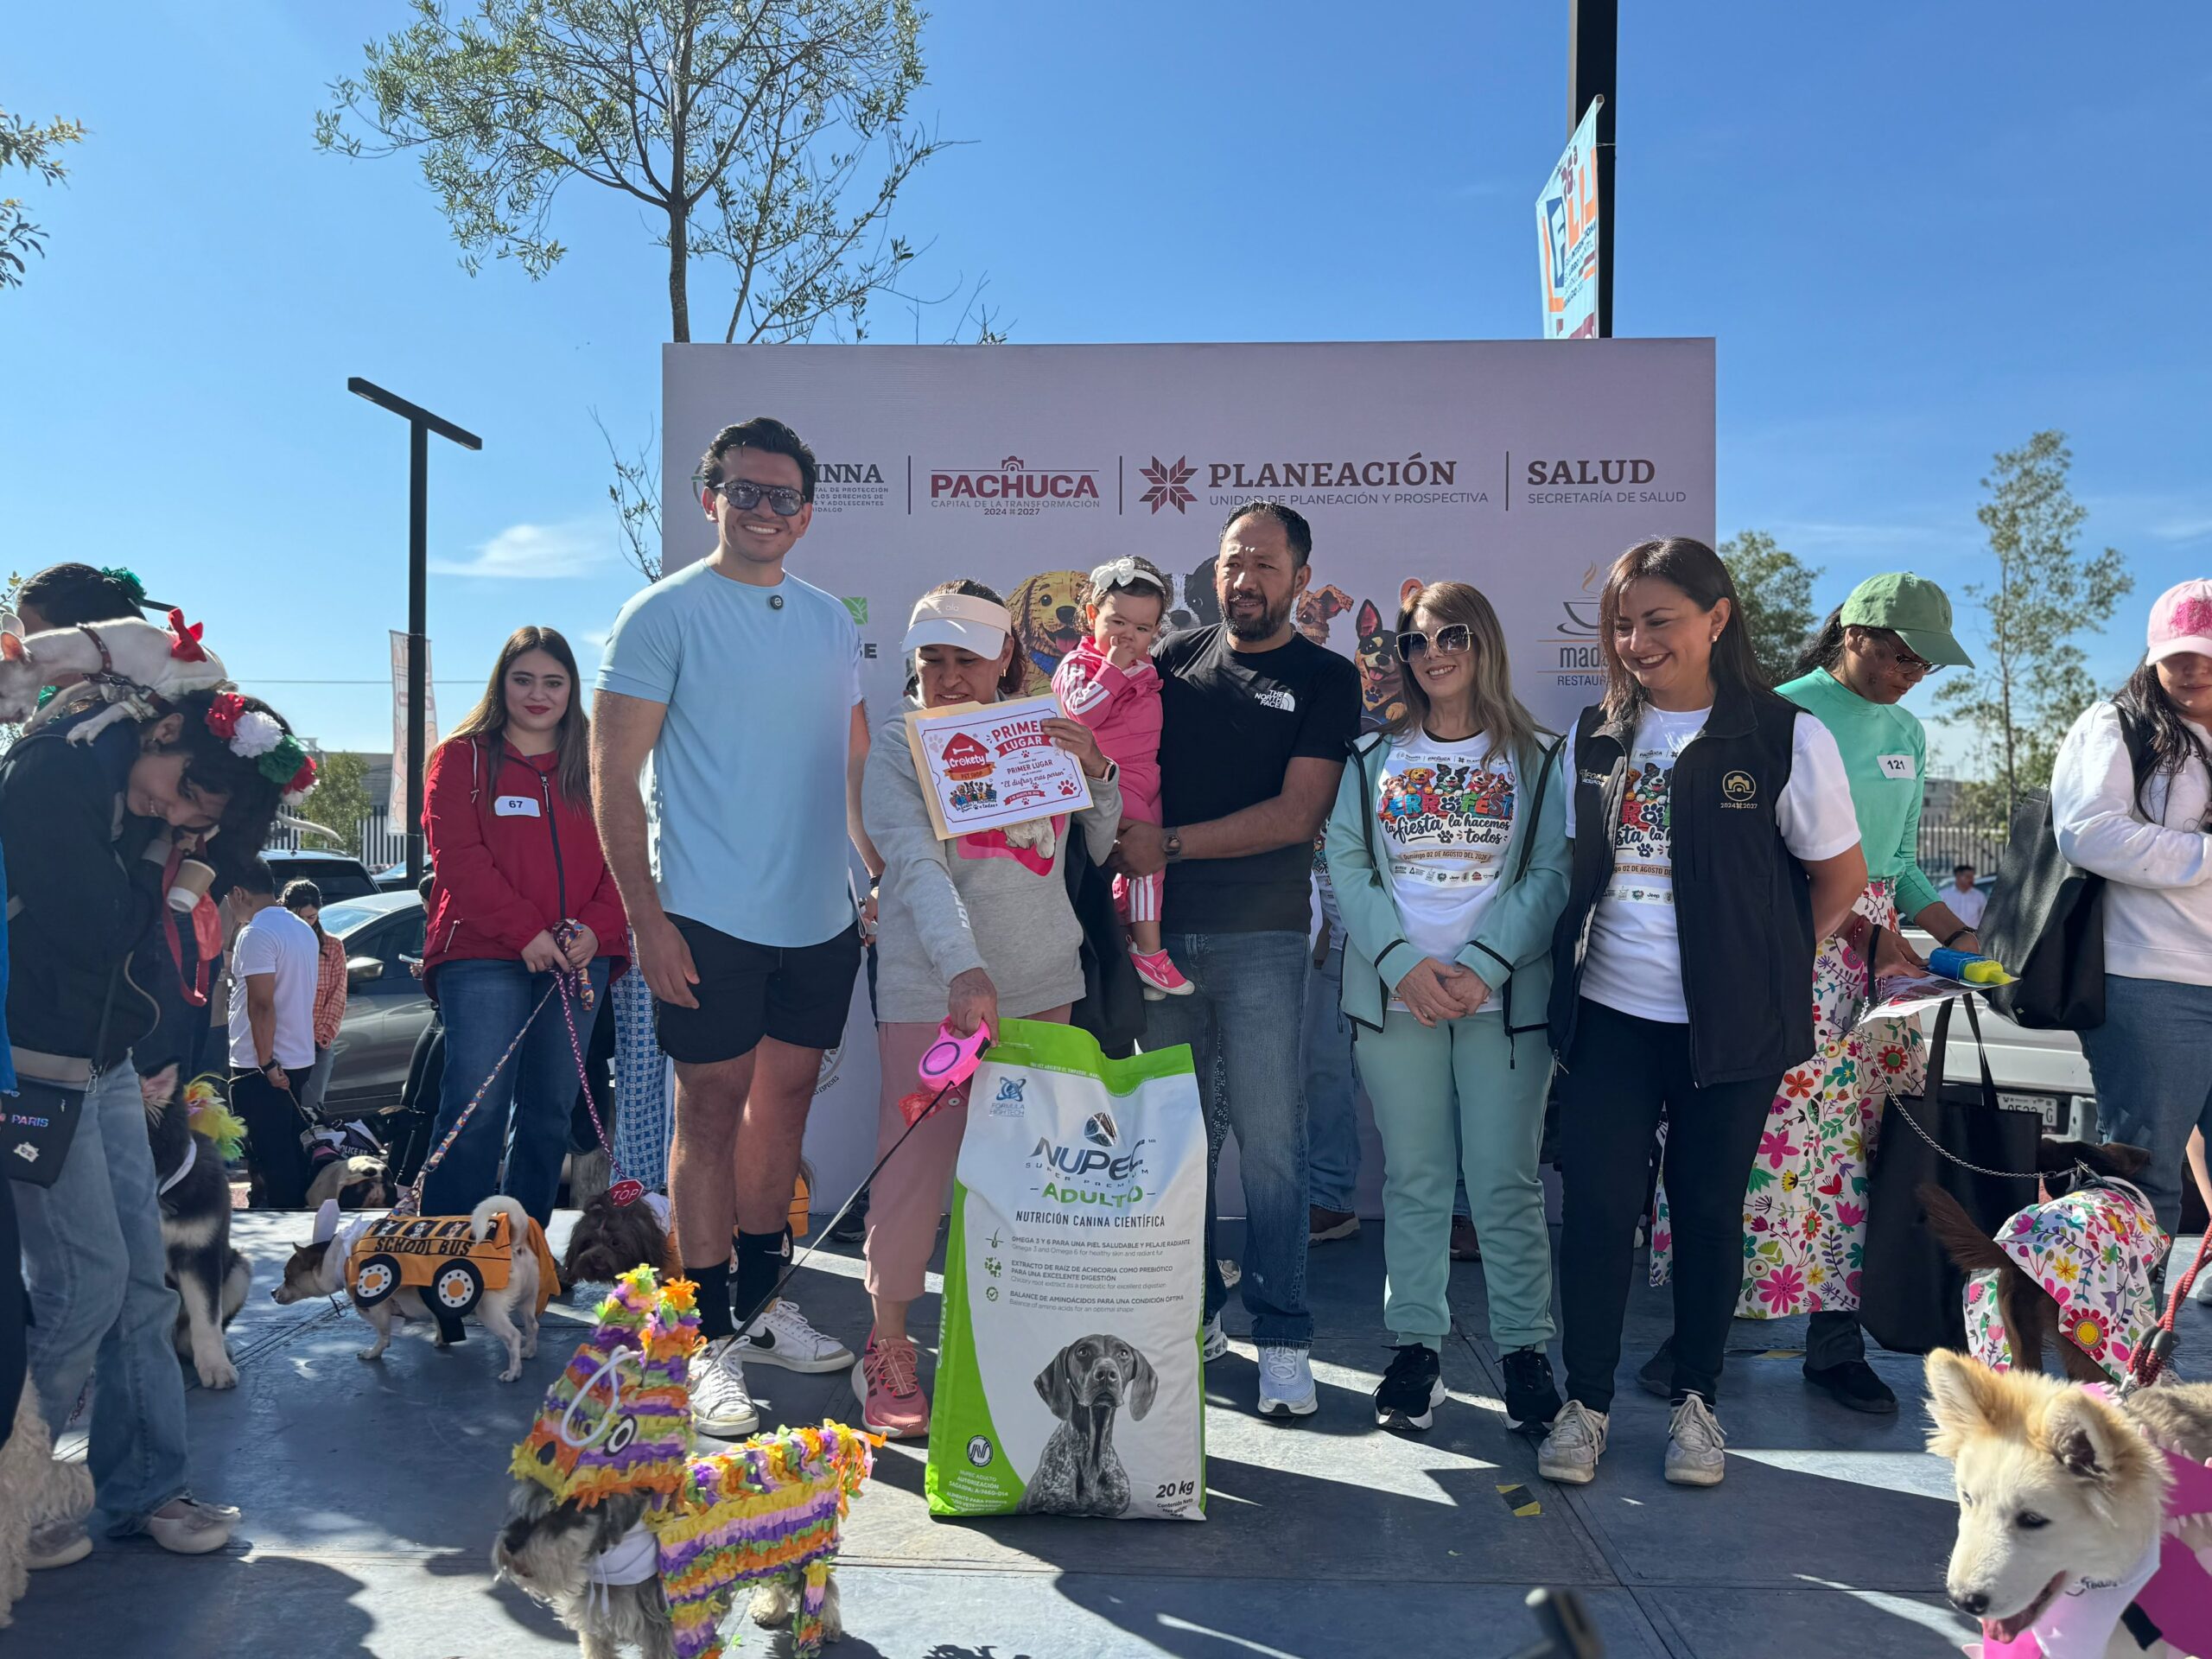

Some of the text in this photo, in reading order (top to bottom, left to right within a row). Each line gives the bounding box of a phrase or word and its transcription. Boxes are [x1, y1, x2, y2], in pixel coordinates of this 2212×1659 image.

[815, 464, 884, 483] INNA
[1208, 452, 1457, 487] PLANEACIÓN
[1528, 460, 1655, 486] SALUD
[931, 474, 1099, 498] PACHUCA
[1005, 498, 1100, 508] TRANSFORMACIÓN
[1210, 493, 1489, 505] UNIDAD DE PLANEACIÓN Y PROSPECTIVA
[1528, 491, 1687, 504] SECRETARÍA DE SALUD
[1255, 693, 1282, 703] NORTH
[1260, 700, 1280, 709] FACE
[991, 721, 1044, 742] PRIME
[1003, 736, 1042, 752] LUGAR
[950, 754, 986, 767] Crokety
[1007, 765, 1031, 774] PRIMER
[1032, 760, 1053, 769] LUGAR
[1887, 760, 1905, 770] 121
[1384, 814, 1510, 844] la fiesta la hacemos
[1464, 827, 1503, 844] todos
[1616, 825, 1644, 846] sta
[1649, 827, 1664, 841] la
[1403, 852, 1426, 861] Domingo
[12, 1114, 49, 1128] PARIS
[340, 1144, 359, 1155] OLICE
[1028, 1136, 1146, 1181] NUPEC
[613, 1188, 639, 1200] TOP
[1041, 1181, 1144, 1208] ADULTO
[1015, 1211, 1166, 1228] NUTRICIÓN CANINA CIENTÍFICA
[374, 1236, 473, 1256] SCHOOL BUS
[1166, 1238, 1191, 1247] RADIANTE
[1011, 1260, 1043, 1270] EXTRACTO
[1042, 1272, 1080, 1281] EXCELENTE
[1010, 1291, 1039, 1300] BALANCE
[1049, 1295, 1096, 1304] AMINOÁCIDOS
[1131, 1296, 1165, 1305] CONDICIÓN
[1155, 1480, 1194, 1498] 20 kg
